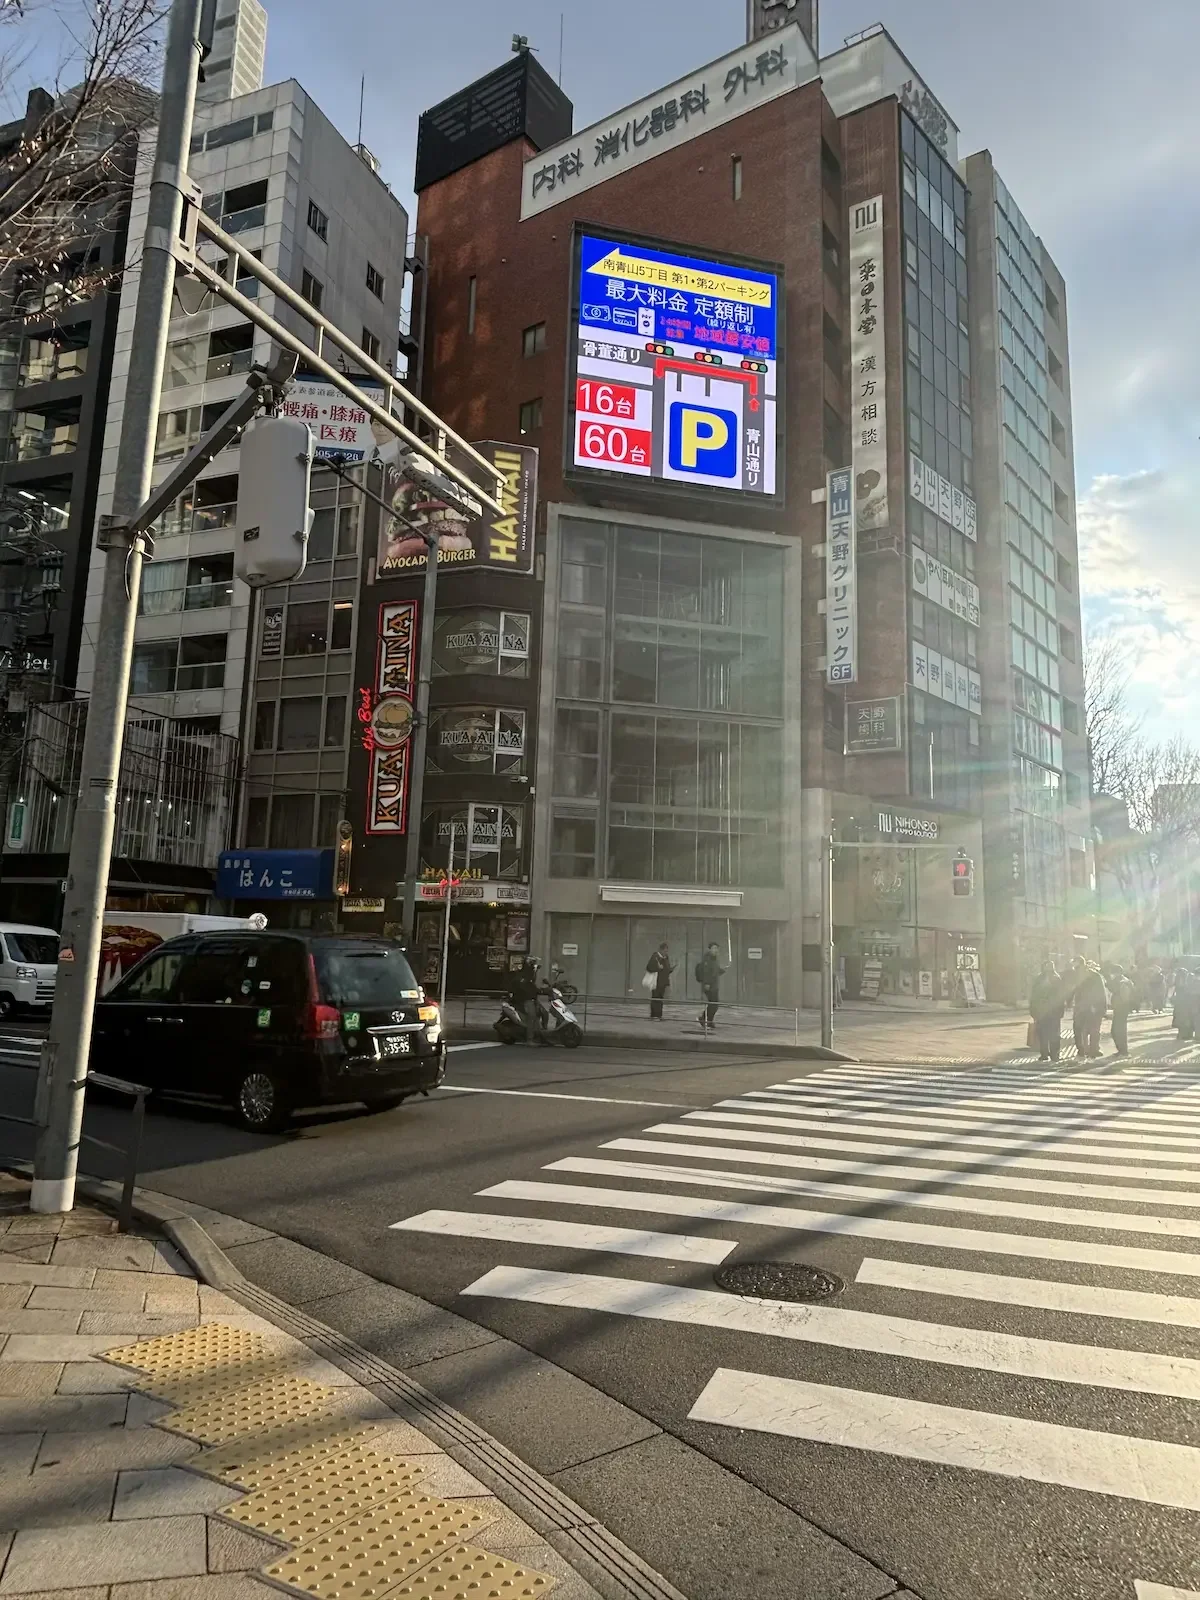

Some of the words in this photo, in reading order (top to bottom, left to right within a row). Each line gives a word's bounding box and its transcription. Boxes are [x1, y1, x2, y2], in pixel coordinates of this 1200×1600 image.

[532, 147, 584, 199] 内科
[593, 83, 710, 168] 消化器科
[722, 43, 789, 103] 外科
[603, 258, 668, 282] 南青山5丁目
[605, 278, 688, 314] 最大料金
[694, 296, 754, 325] 定額制
[283, 400, 366, 424] 腰痛・膝痛
[860, 355, 878, 446] 漢方相談
[681, 408, 729, 468] P
[745, 428, 761, 486] 青山通り
[437, 549, 476, 563] BURGER
[831, 475, 850, 663] 青山天野クリニック
[446, 632, 477, 649] KUA
[831, 664, 851, 681] 6F
[374, 748, 404, 827] KUA
[240, 868, 293, 888] はんこ
